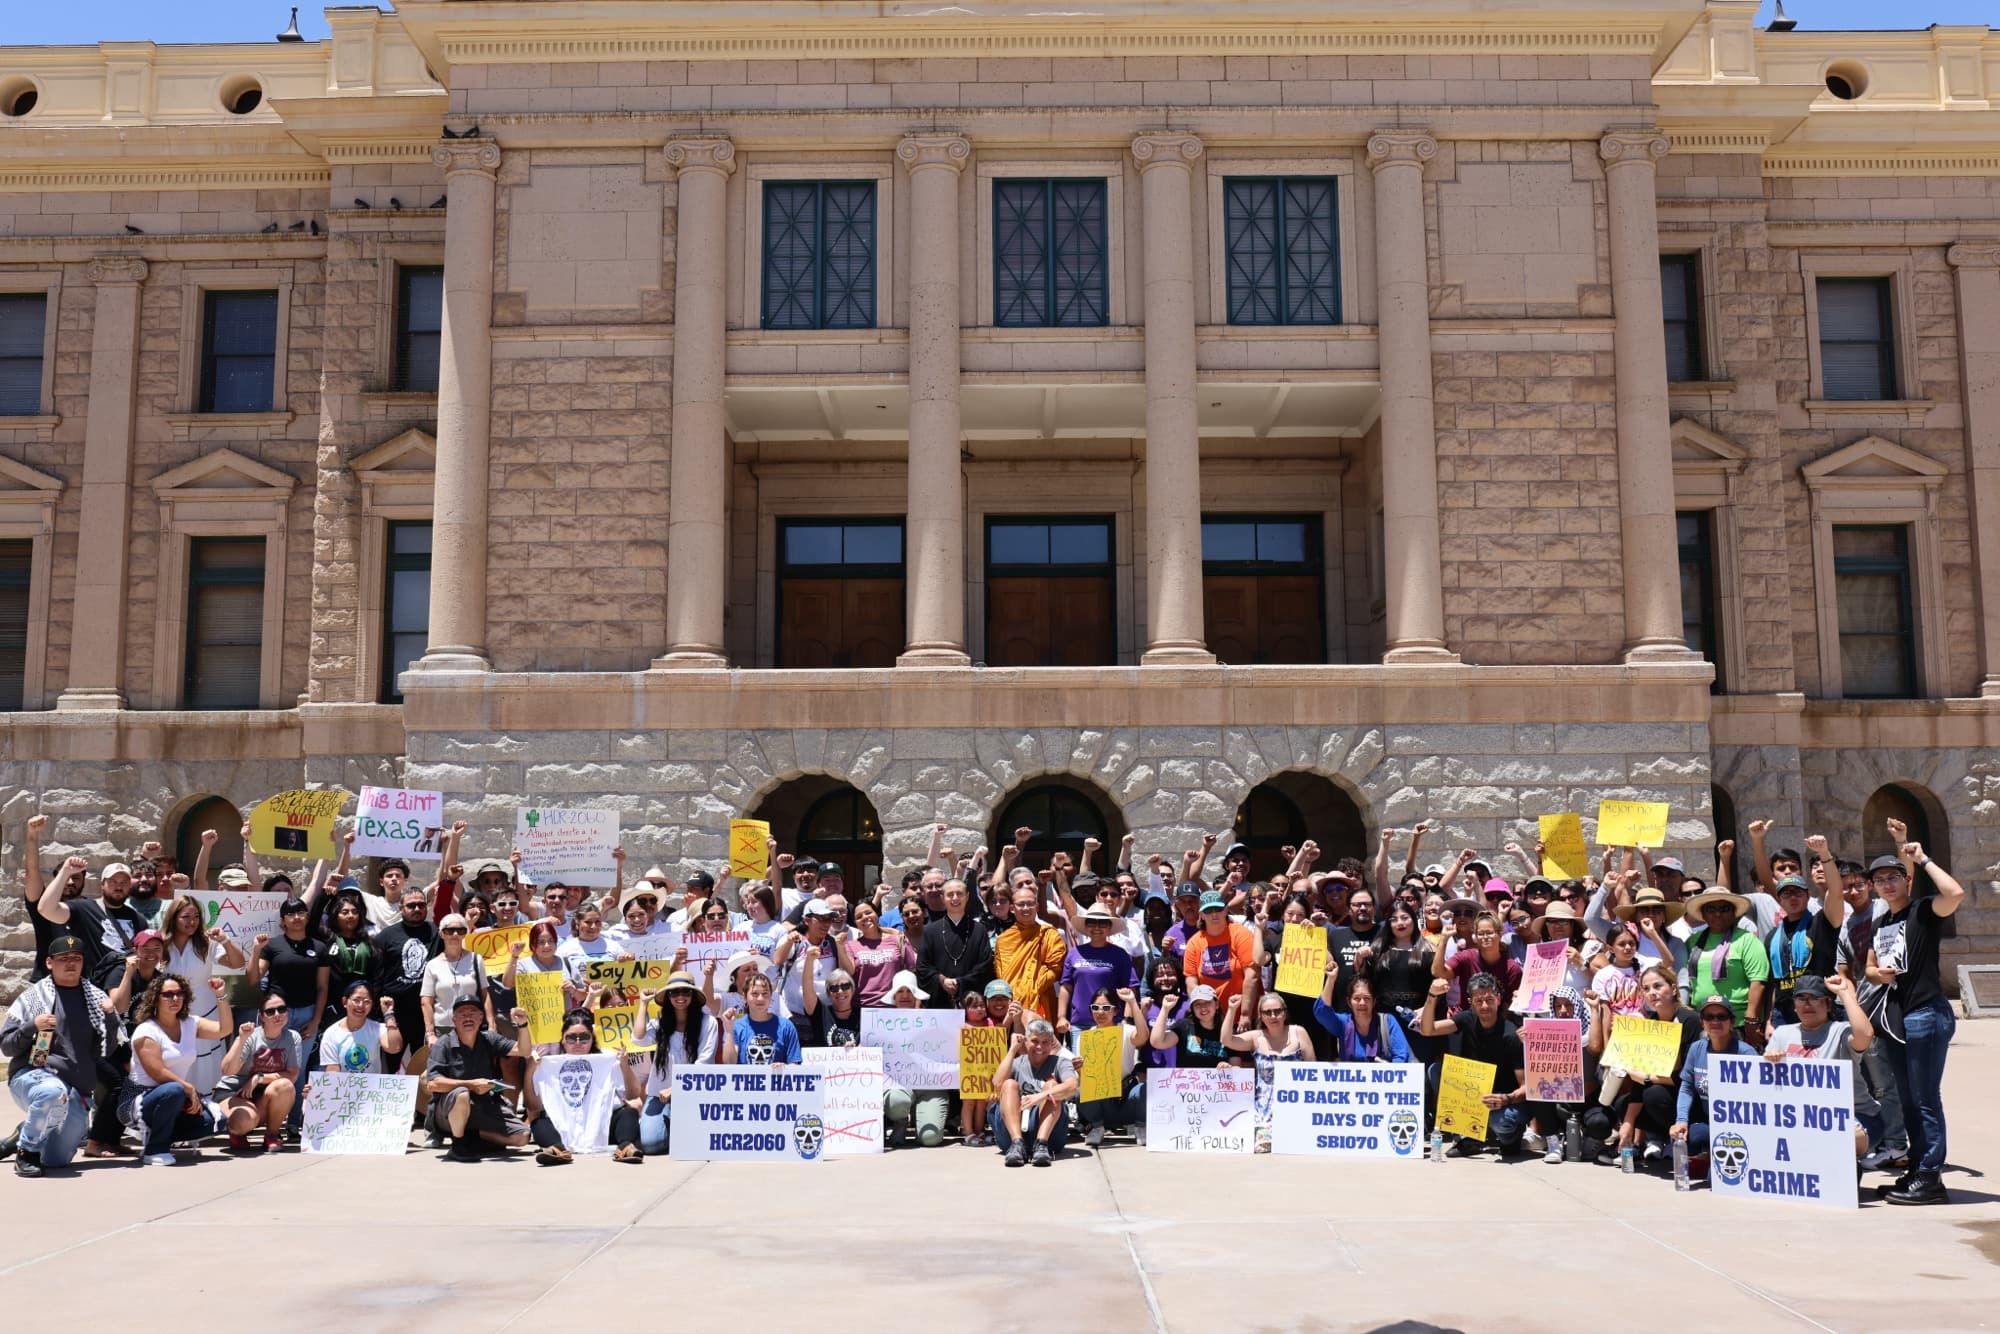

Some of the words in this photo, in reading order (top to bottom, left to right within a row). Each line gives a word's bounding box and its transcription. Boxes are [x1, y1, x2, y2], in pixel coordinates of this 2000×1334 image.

[362, 786, 389, 810] This
[395, 791, 436, 812] aint
[355, 816, 421, 839] Texas
[222, 918, 276, 937] Against
[682, 932, 722, 944] FINISH
[726, 930, 749, 942] HIM
[1284, 947, 1323, 969] HATE
[589, 962, 624, 983] Say
[519, 997, 562, 1013] PROFILE
[1616, 1016, 1638, 1033] NO
[961, 1028, 1007, 1047] BROWN
[964, 1046, 1002, 1064] SKIN
[1529, 1042, 1578, 1054] PROPUESTA
[1205, 1070, 1233, 1081] Purple
[1291, 1068, 1318, 1082] WE
[1323, 1069, 1366, 1083] WILL
[1371, 1070, 1407, 1083] NOT
[1530, 1062, 1578, 1074] RESPUESTA
[1719, 1060, 1752, 1084] MY
[1759, 1062, 1841, 1090] BROWN
[311, 1073, 332, 1087] WE
[337, 1074, 369, 1089] WERE
[378, 1077, 407, 1091] HERE
[732, 1073, 767, 1092] THE
[961, 1074, 997, 1094] CRIM
[1240, 1081, 1253, 1091] US
[356, 1090, 384, 1102] YEARS
[1179, 1092, 1201, 1103] YOU
[1277, 1090, 1299, 1103] GO
[1304, 1090, 1350, 1104] BACK
[1355, 1091, 1379, 1105] TO
[1385, 1092, 1420, 1106] THE
[308, 1098, 326, 1111] WE
[338, 1101, 366, 1116] ARE
[374, 1103, 402, 1117] HERE
[699, 1104, 744, 1121] VOTE
[748, 1104, 772, 1121] NO
[776, 1104, 798, 1121] ON
[1187, 1104, 1208, 1114] SEE
[1713, 1099, 1767, 1126] SKIN
[1774, 1103, 1796, 1129] IS
[1803, 1104, 1850, 1132] NOT
[1187, 1116, 1202, 1126] US
[1312, 1112, 1357, 1127] DAYS
[1362, 1113, 1384, 1127] OF
[304, 1122, 325, 1135] WE
[1189, 1126, 1201, 1136] AT
[709, 1133, 786, 1151] HCR2060
[1170, 1136, 1193, 1150] THE
[1202, 1136, 1244, 1152] POLLS!
[1316, 1135, 1378, 1150] SB1070
[1775, 1138, 1790, 1162] A
[1748, 1168, 1820, 1198] CRIME
